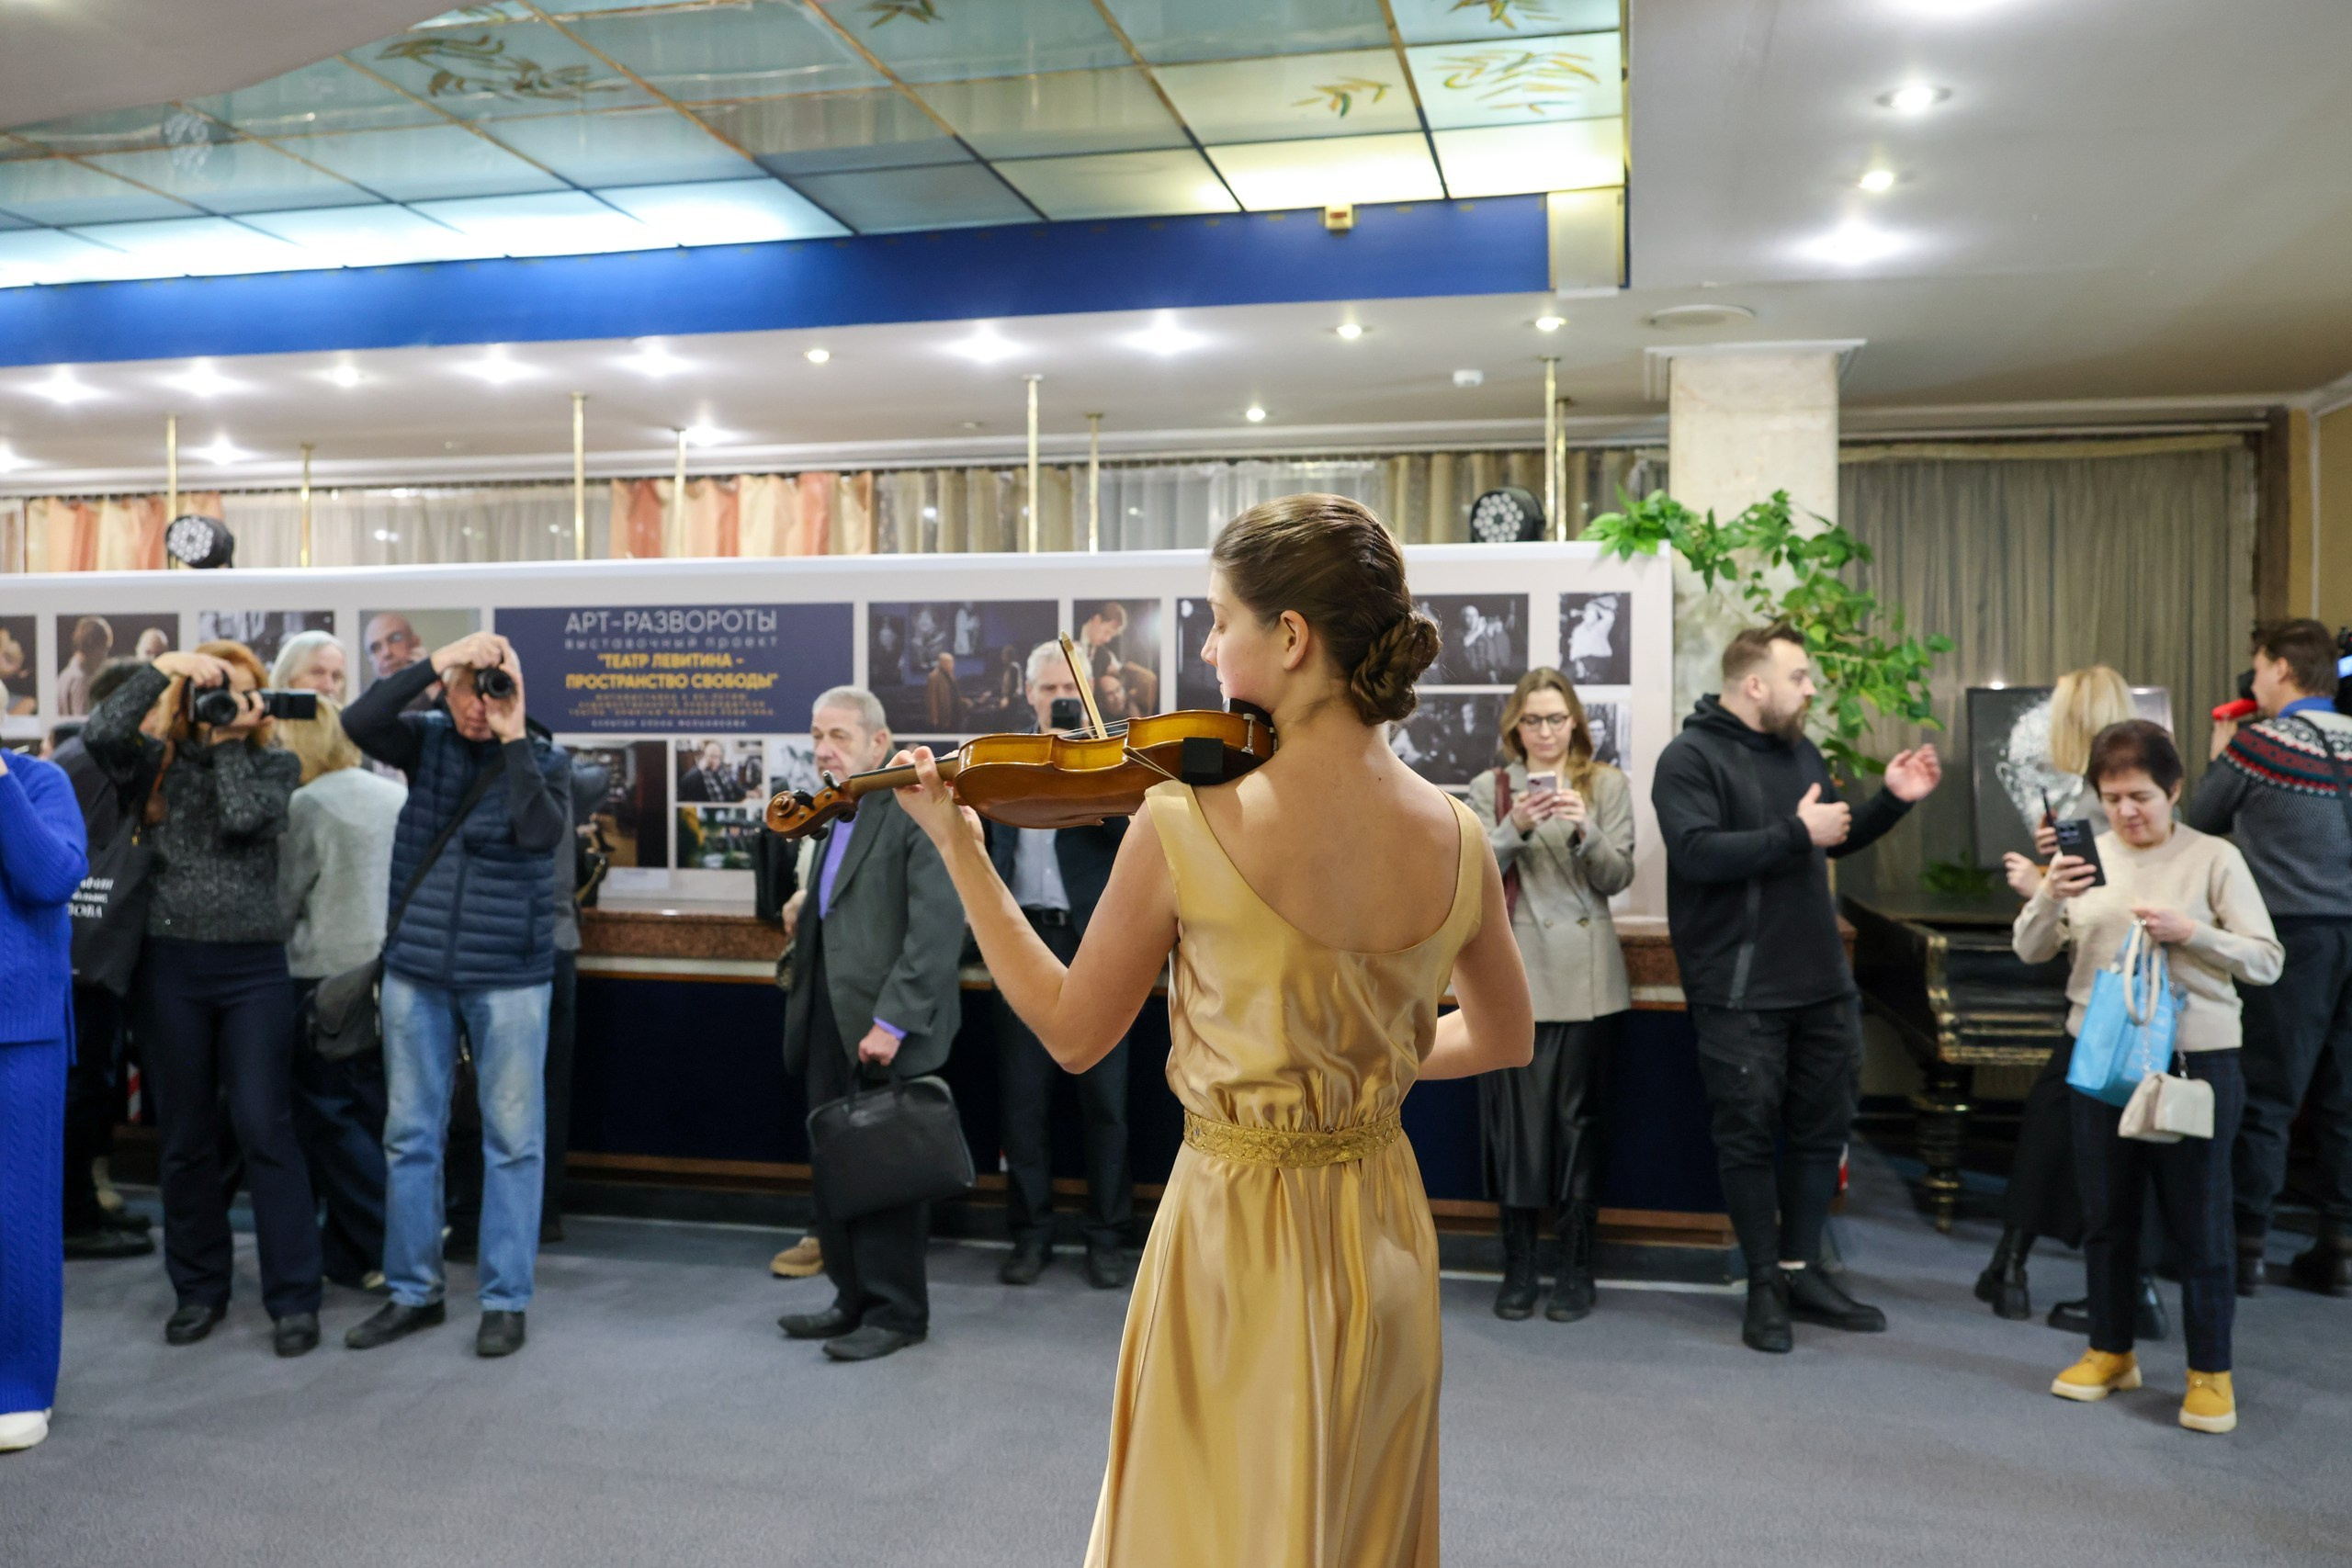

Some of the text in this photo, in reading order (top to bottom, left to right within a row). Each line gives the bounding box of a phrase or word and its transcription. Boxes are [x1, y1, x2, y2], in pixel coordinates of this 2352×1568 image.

[564, 610, 777, 634] АРТ-РАЗВОРОТЫ
[564, 637, 778, 650] выставочный проект
[597, 653, 650, 669] "ТЕАТР
[651, 653, 733, 669] ЛЕВИТИНА
[565, 673, 779, 691] ПРОСТРАНСТВО СВОБОДЫ"
